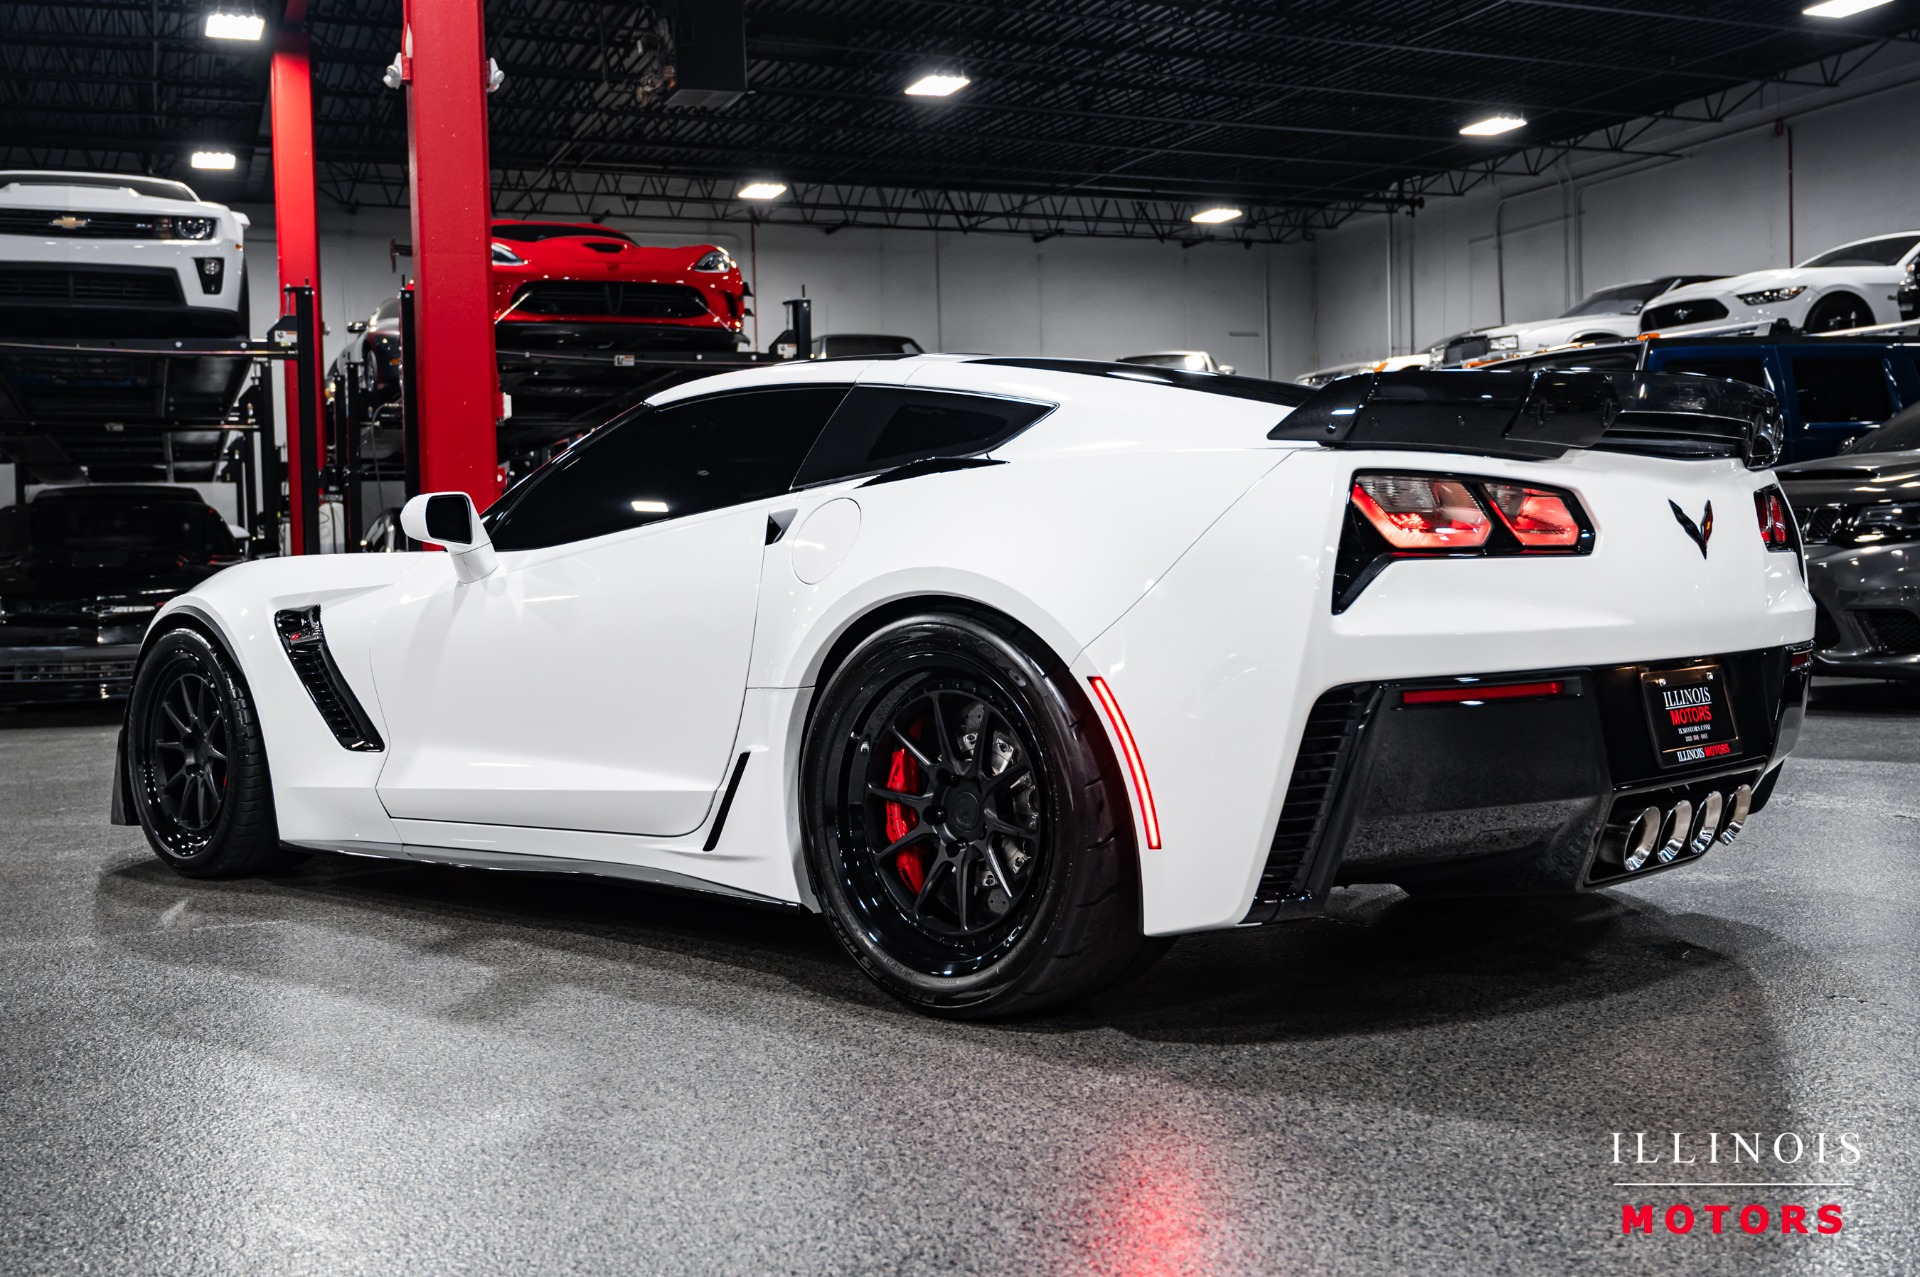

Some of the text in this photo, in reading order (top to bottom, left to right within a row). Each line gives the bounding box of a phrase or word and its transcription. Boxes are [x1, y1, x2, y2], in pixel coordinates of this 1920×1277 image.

[1663, 687, 1711, 707] ILLINOIS
[1670, 705, 1712, 725] MOTORS
[1677, 743, 1730, 762] ILLINOIS MOTORS
